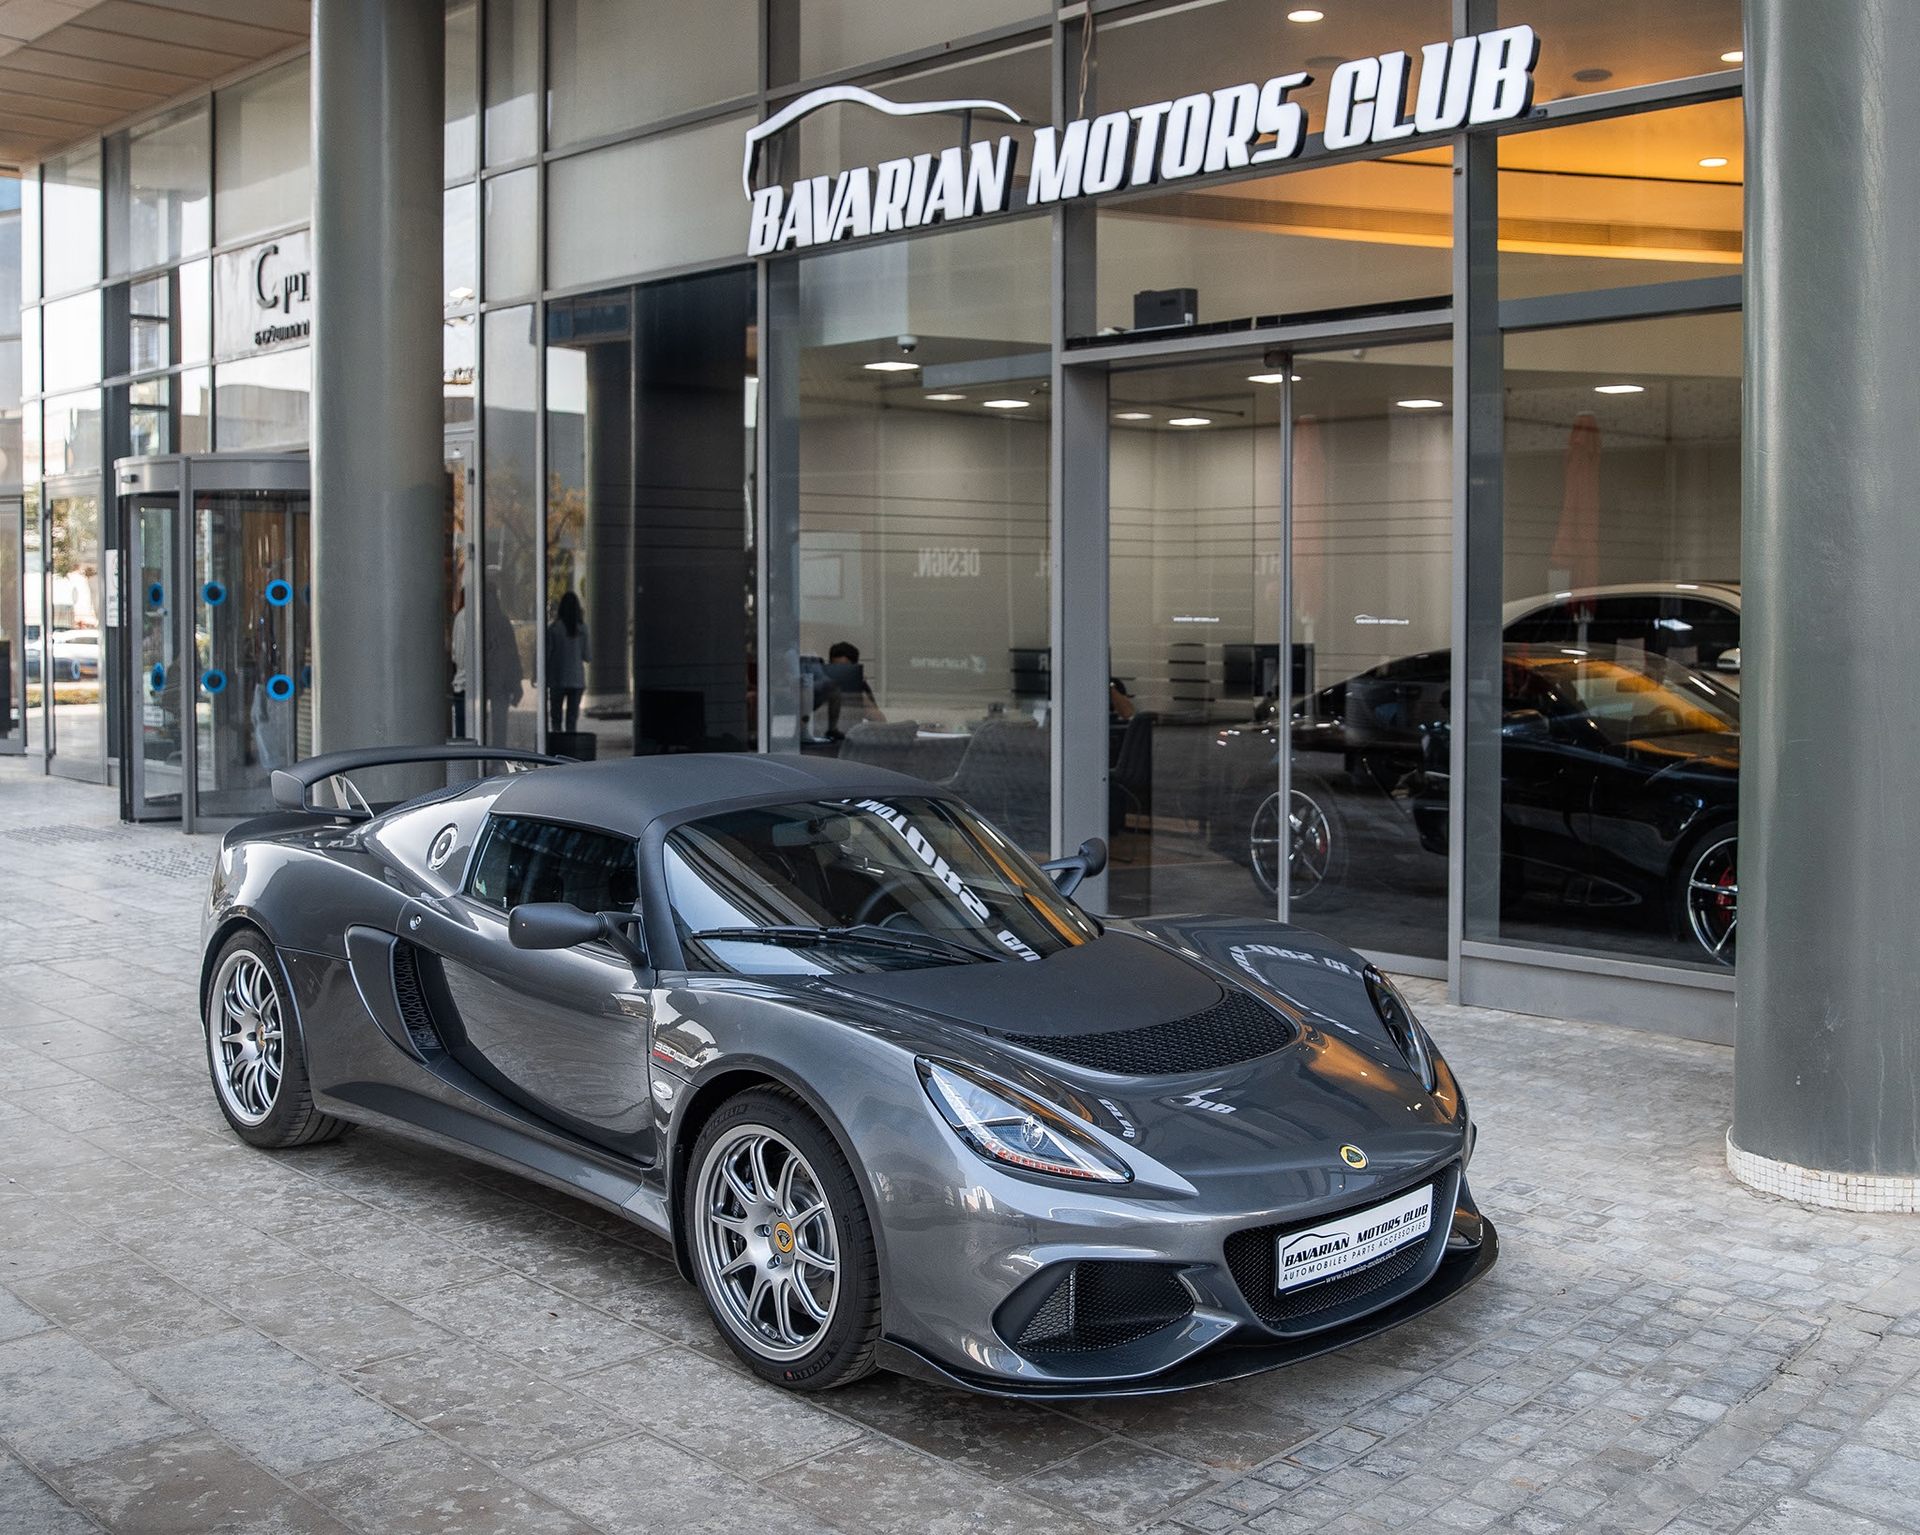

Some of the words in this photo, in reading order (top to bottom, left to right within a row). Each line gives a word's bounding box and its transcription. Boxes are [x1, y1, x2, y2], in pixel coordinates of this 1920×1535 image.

[747, 136, 1015, 256] BAVARIAN
[1027, 72, 1308, 206] MOTORS
[1323, 24, 1536, 150] CLUB
[1283, 1254, 1348, 1282] AUTOMOBILES
[1351, 1243, 1375, 1260] PARTS
[1378, 1220, 1426, 1249] ACCESSORIES
[1284, 1236, 1350, 1268] BAVARIAN
[1356, 1215, 1401, 1244] MOTORS
[1402, 1203, 1429, 1224] CLUB
